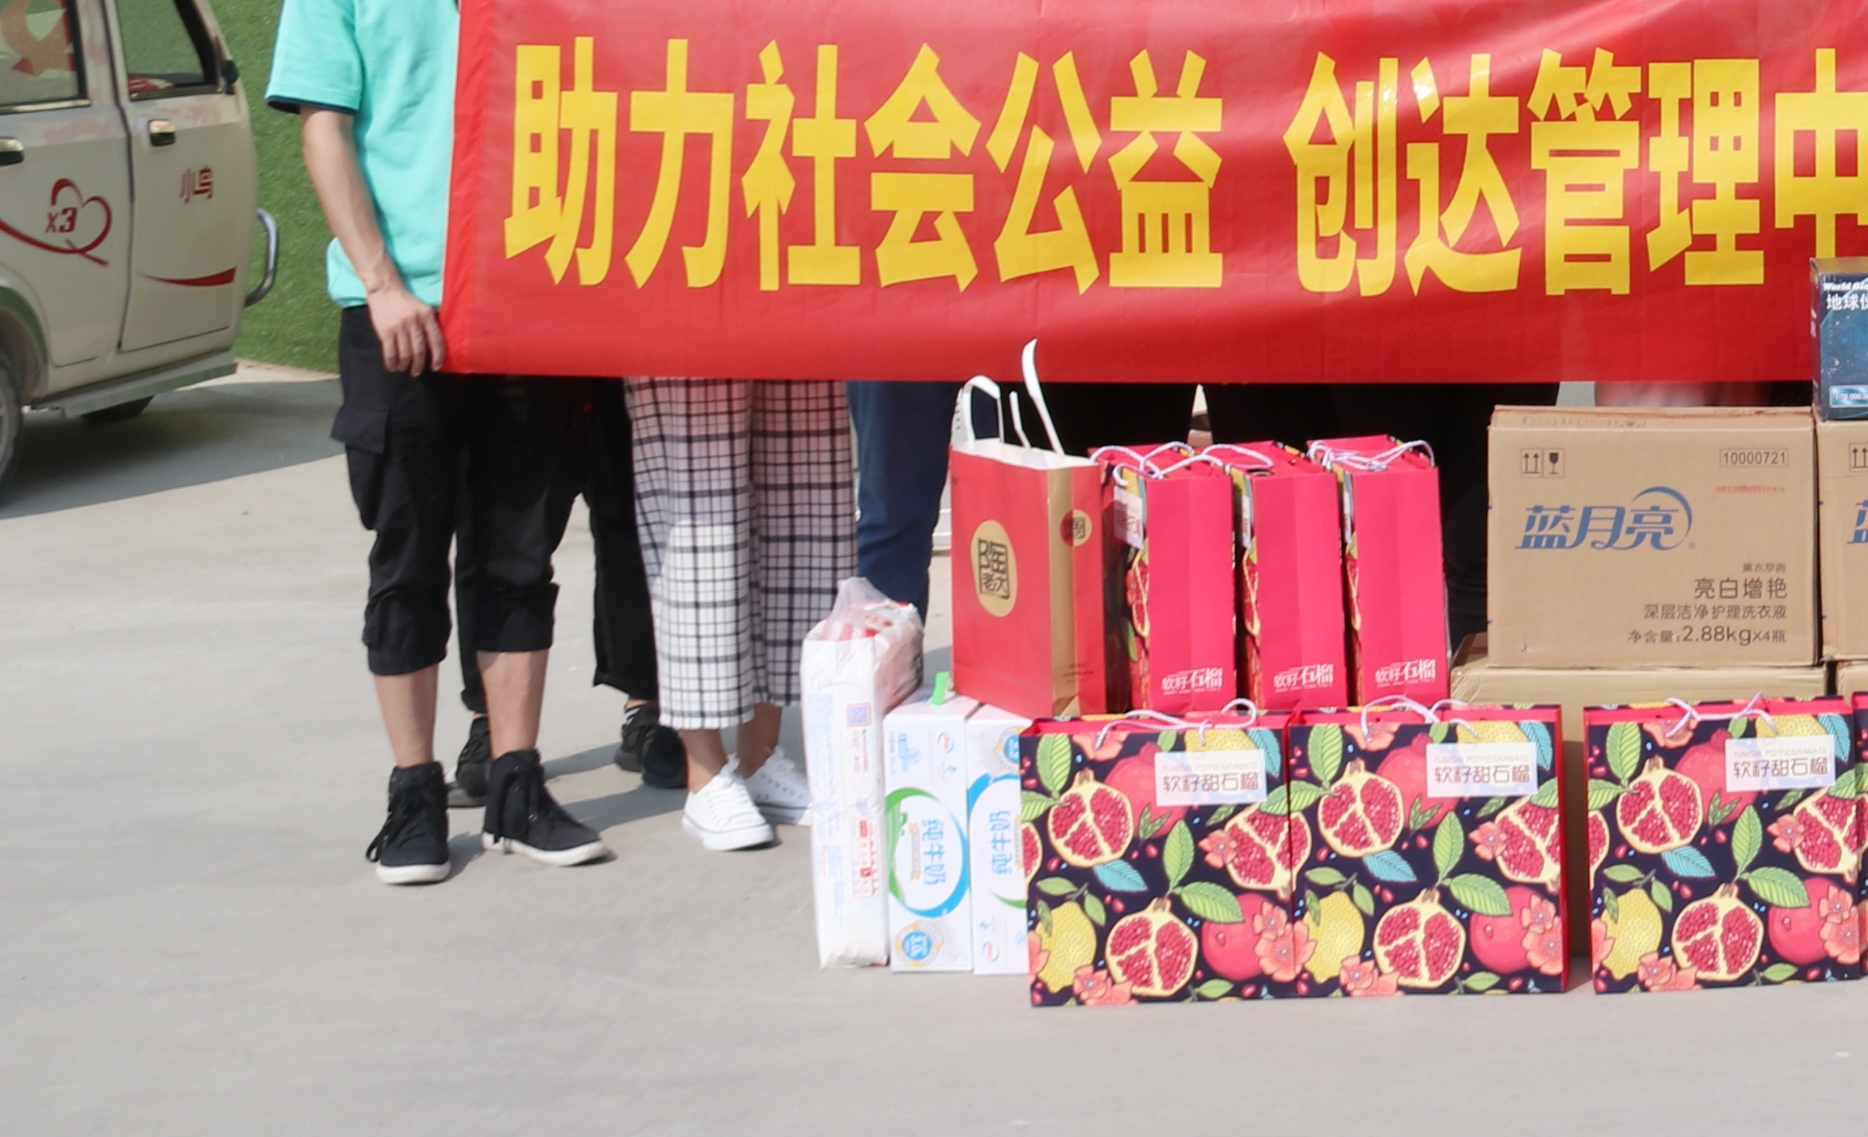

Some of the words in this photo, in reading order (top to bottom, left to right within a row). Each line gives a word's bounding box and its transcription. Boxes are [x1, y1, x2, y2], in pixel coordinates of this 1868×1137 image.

[503, 36, 1223, 295] 助力社会公益
[1823, 282, 1852, 291] World
[1722, 451, 1787, 465] 10000721
[1514, 502, 1692, 551] 蓝月亮
[1694, 578, 1788, 600] 亮白增艳
[1643, 604, 1787, 620] 深层洁净护理洗衣液
[1161, 667, 1223, 689] 软籽石榴
[1273, 664, 1334, 687] 软籽石榴
[1375, 658, 1436, 682] 软籽石榴
[1434, 765, 1530, 784] 软籽甜石榴
[1733, 756, 1828, 778] 软籽甜石榴
[1163, 772, 1259, 793] 软籽甜石榴
[921, 819, 946, 886] 纯牛奶
